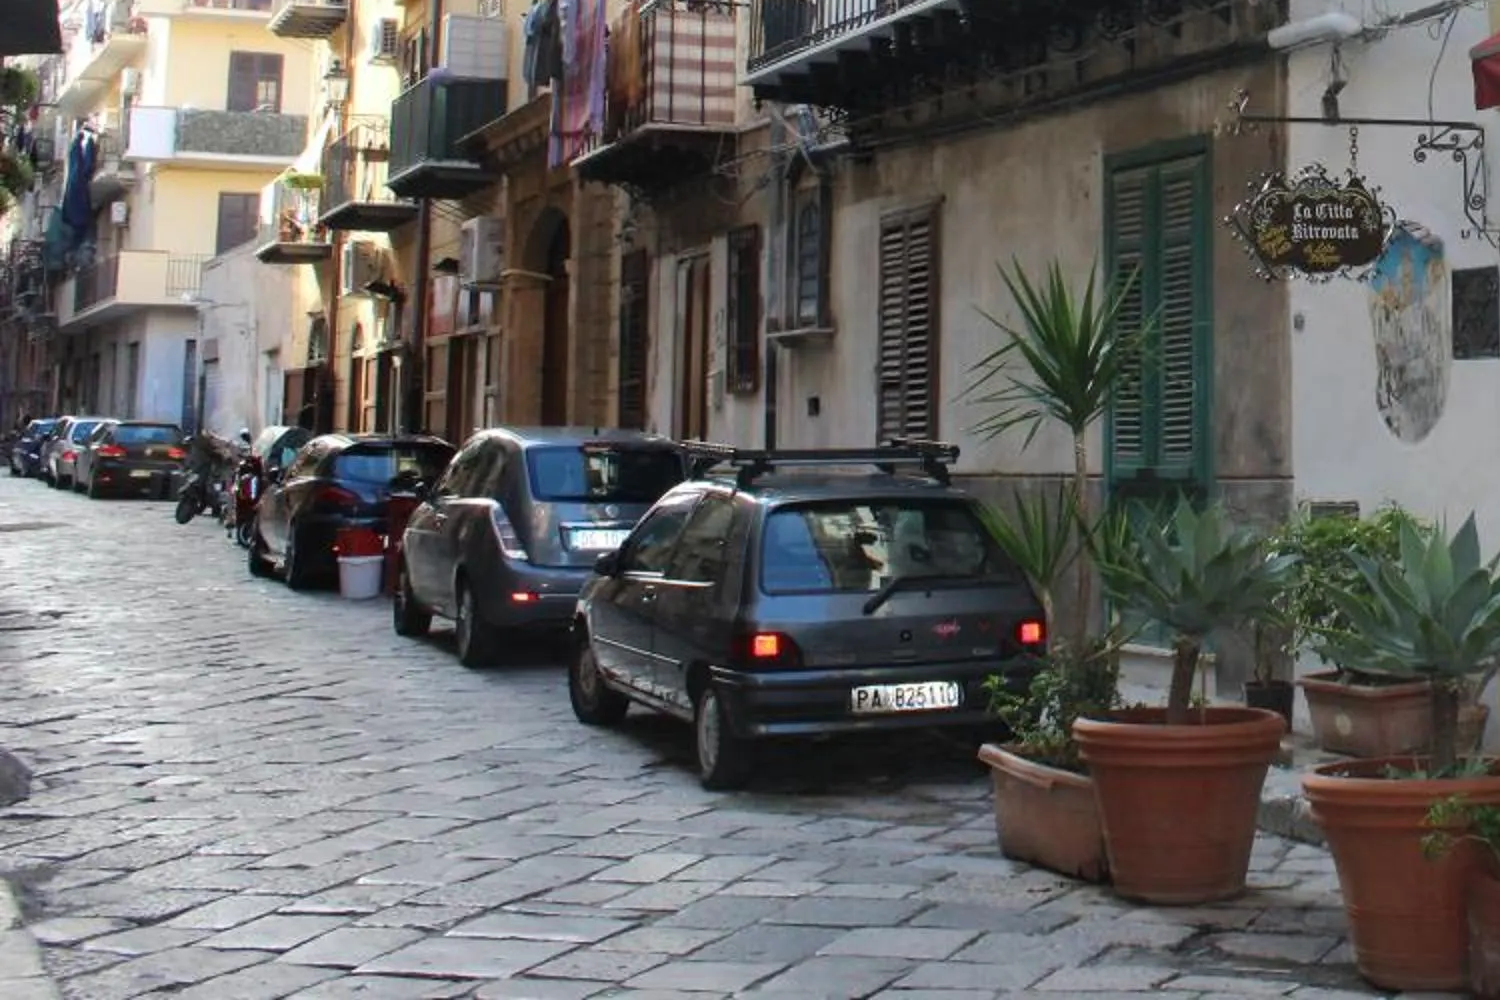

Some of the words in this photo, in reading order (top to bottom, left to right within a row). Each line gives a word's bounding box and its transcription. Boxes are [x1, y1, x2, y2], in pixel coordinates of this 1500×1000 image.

[1293, 203, 1312, 222] La
[1292, 222, 1359, 242] Ritrovata
[857, 689, 882, 709] PA
